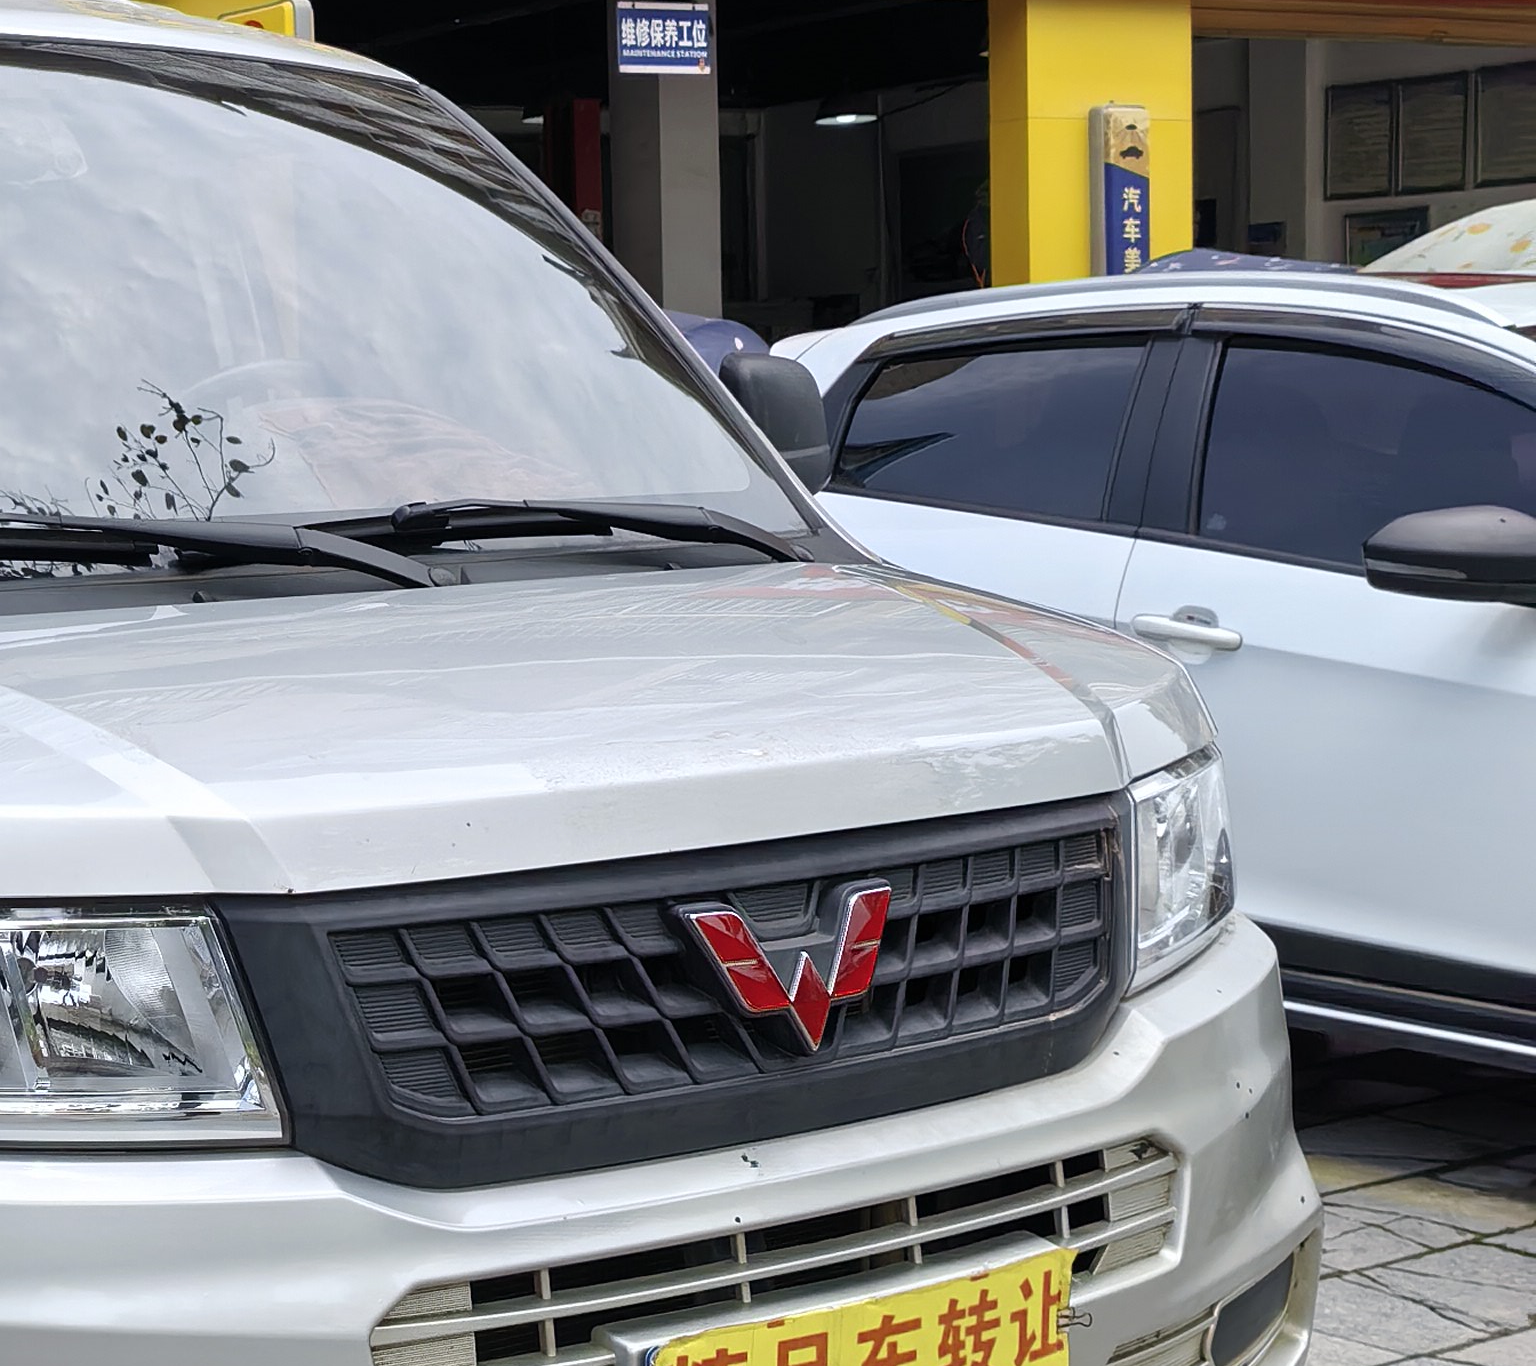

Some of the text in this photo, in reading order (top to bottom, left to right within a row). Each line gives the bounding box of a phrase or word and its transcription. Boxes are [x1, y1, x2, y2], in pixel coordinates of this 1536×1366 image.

[621, 16, 708, 49] 维修保养工位
[622, 49, 708, 60] MAINTENANCE STATION
